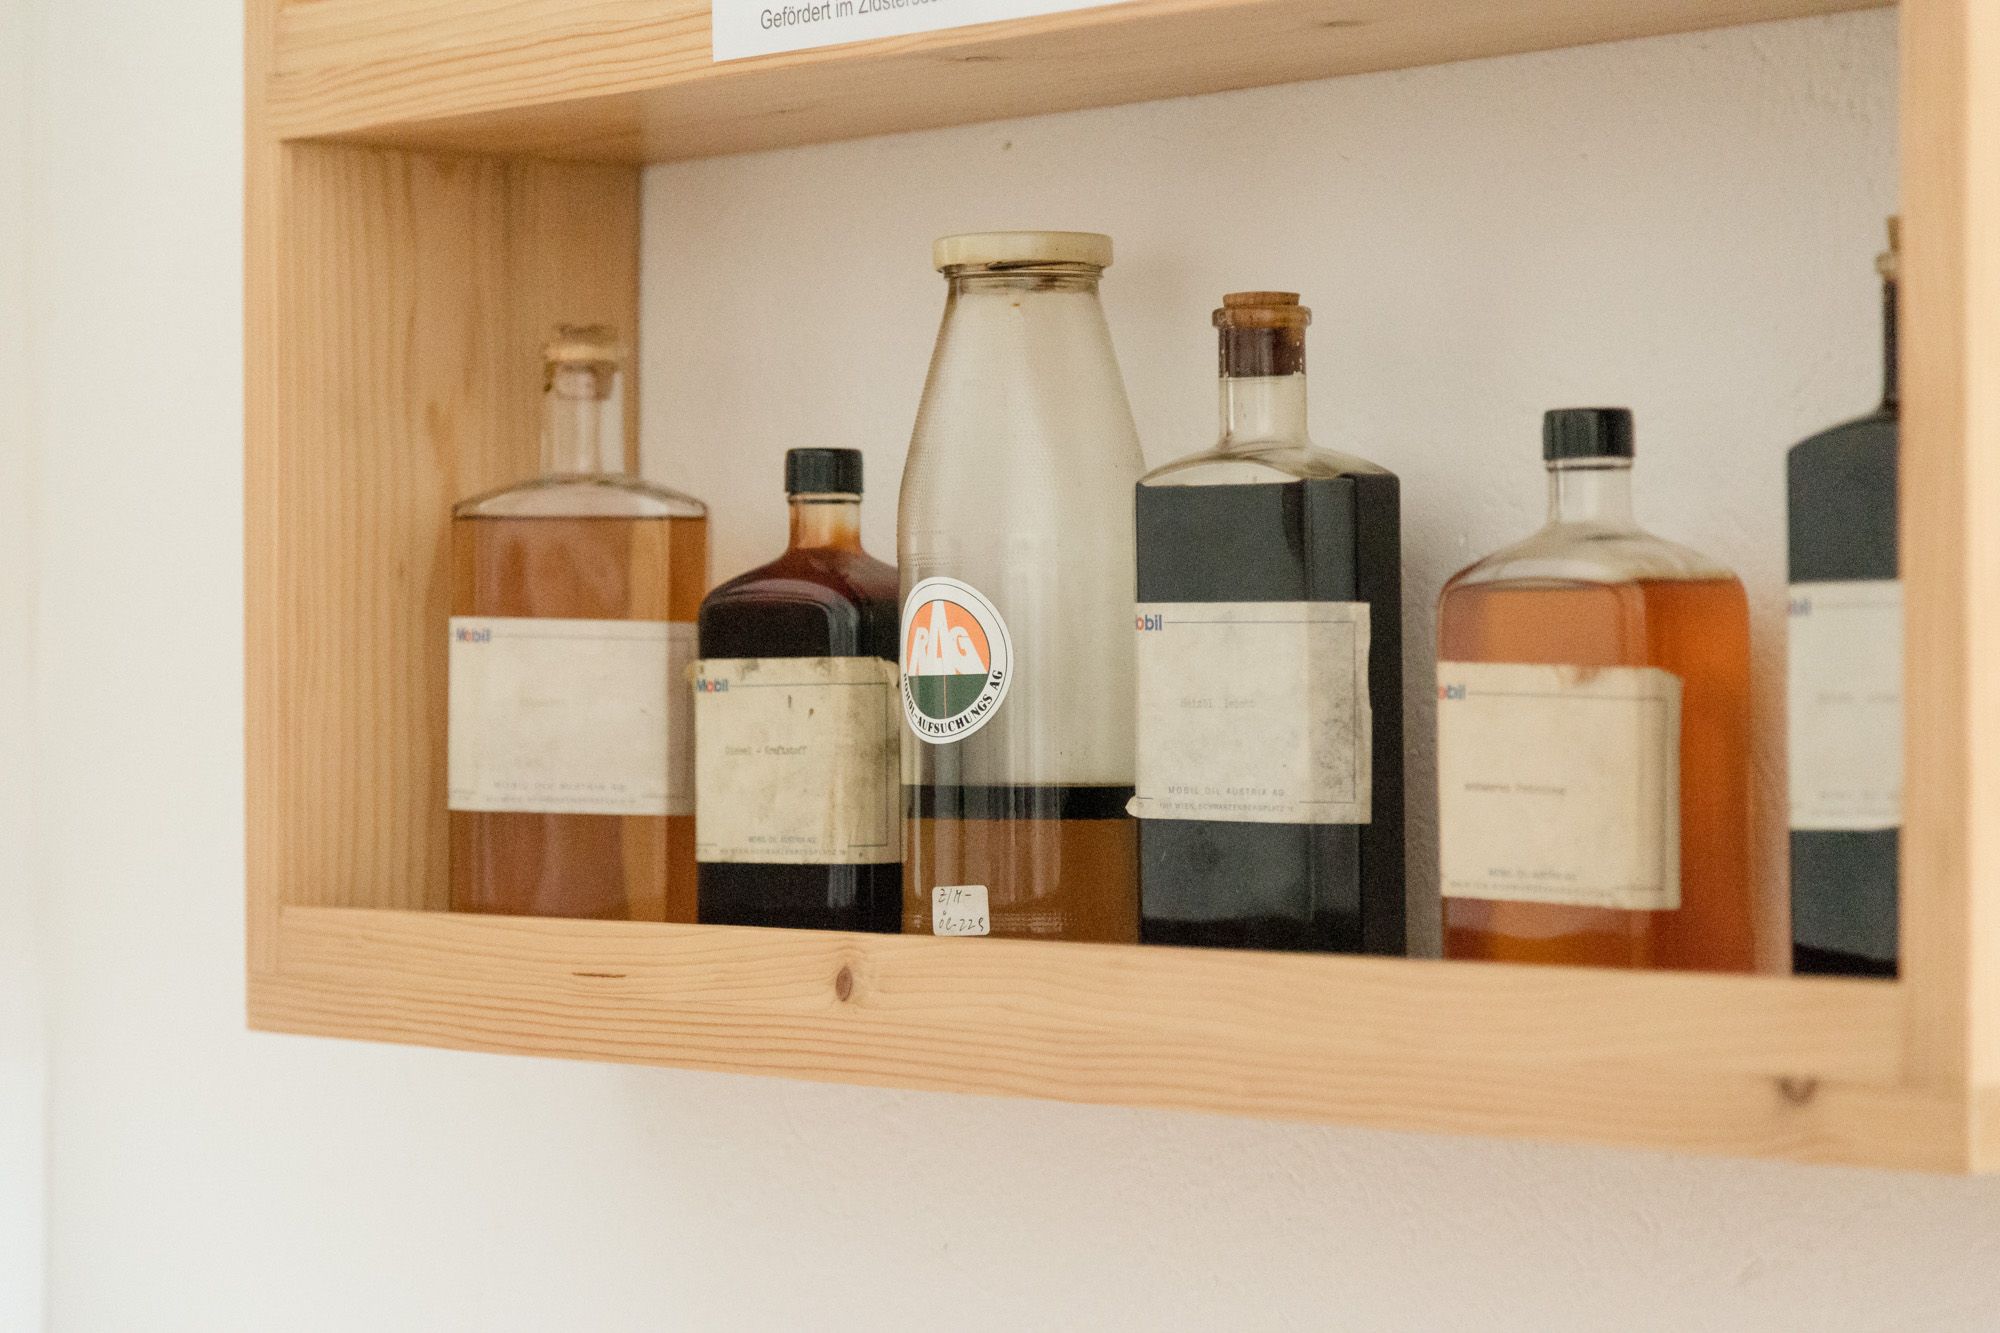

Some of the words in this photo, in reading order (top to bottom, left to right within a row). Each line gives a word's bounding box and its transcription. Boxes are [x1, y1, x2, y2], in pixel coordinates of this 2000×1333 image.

[760, 0, 831, 30] Gefördert
[836, 0, 854, 17] im
[1136, 614, 1163, 631] obil
[455, 627, 491, 643] Mobil
[908, 600, 989, 676] RAG
[697, 679, 729, 692] Mobil
[989, 669, 1003, 691] AG
[1168, 786, 1200, 795] MOBIL
[1226, 787, 1266, 796] AUSTRIA
